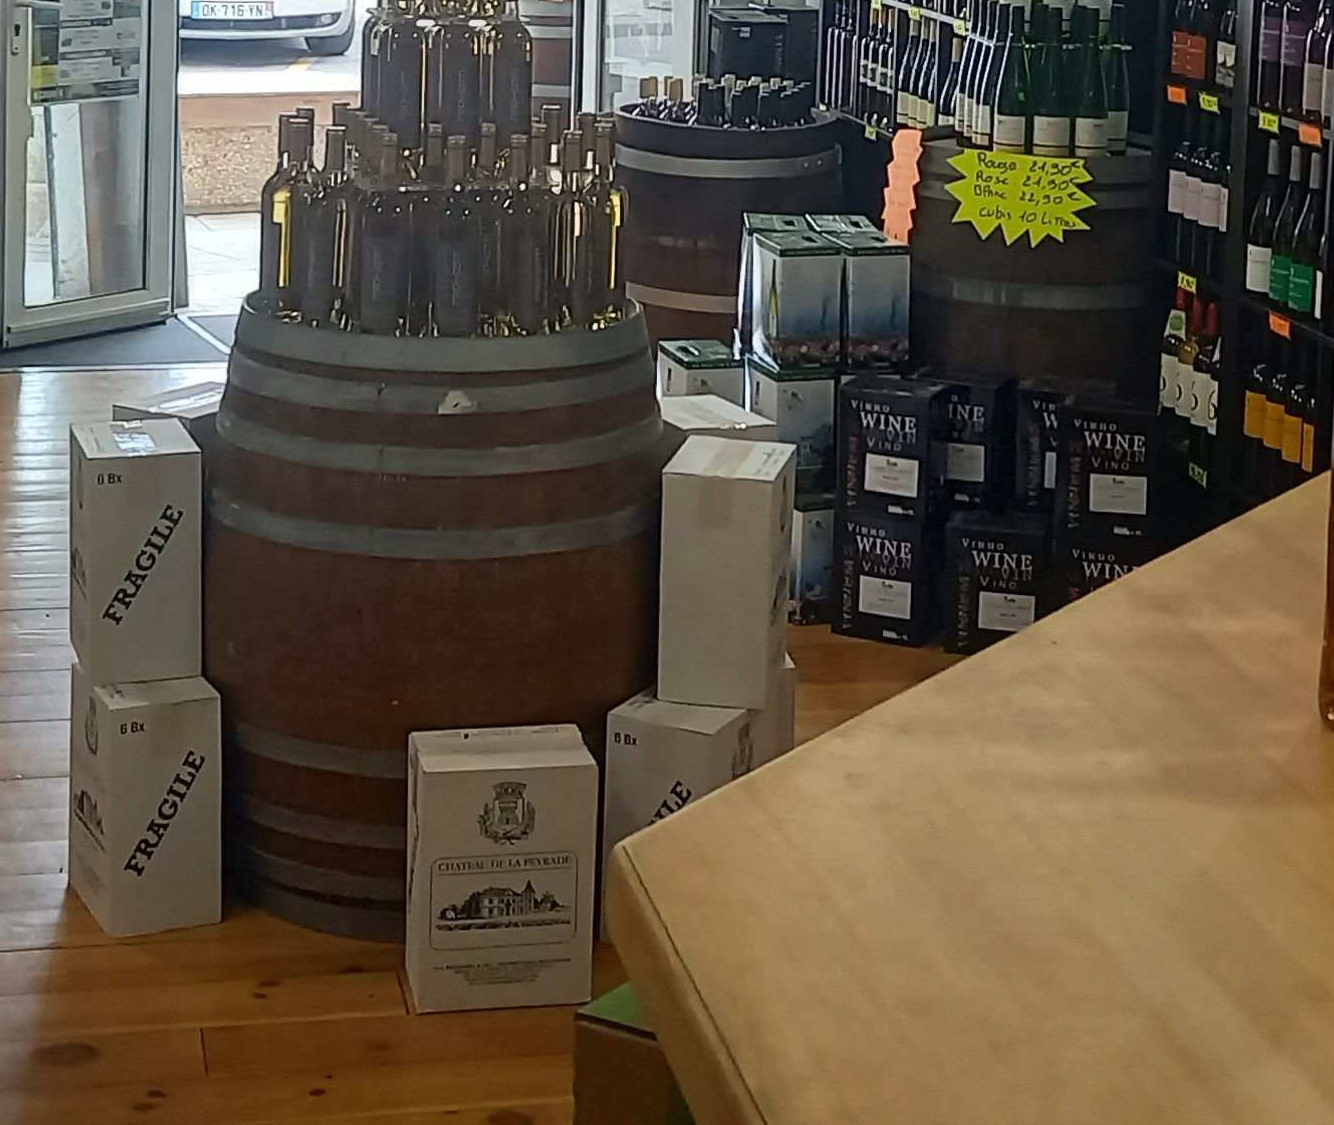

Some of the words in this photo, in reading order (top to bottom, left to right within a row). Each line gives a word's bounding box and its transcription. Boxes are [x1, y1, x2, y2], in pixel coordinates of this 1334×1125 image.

[1019, 211, 1037, 223] 10
[859, 411, 917, 433] WINE
[947, 405, 985, 423] INE
[1083, 430, 1146, 452] WINE
[855, 534, 912, 559] WINE
[101, 504, 184, 627] FRAGILE
[970, 550, 1034, 571] WINE
[1081, 561, 1139, 580] WIN
[123, 750, 207, 878] FRAGILE
[508, 859, 521, 869] LA
